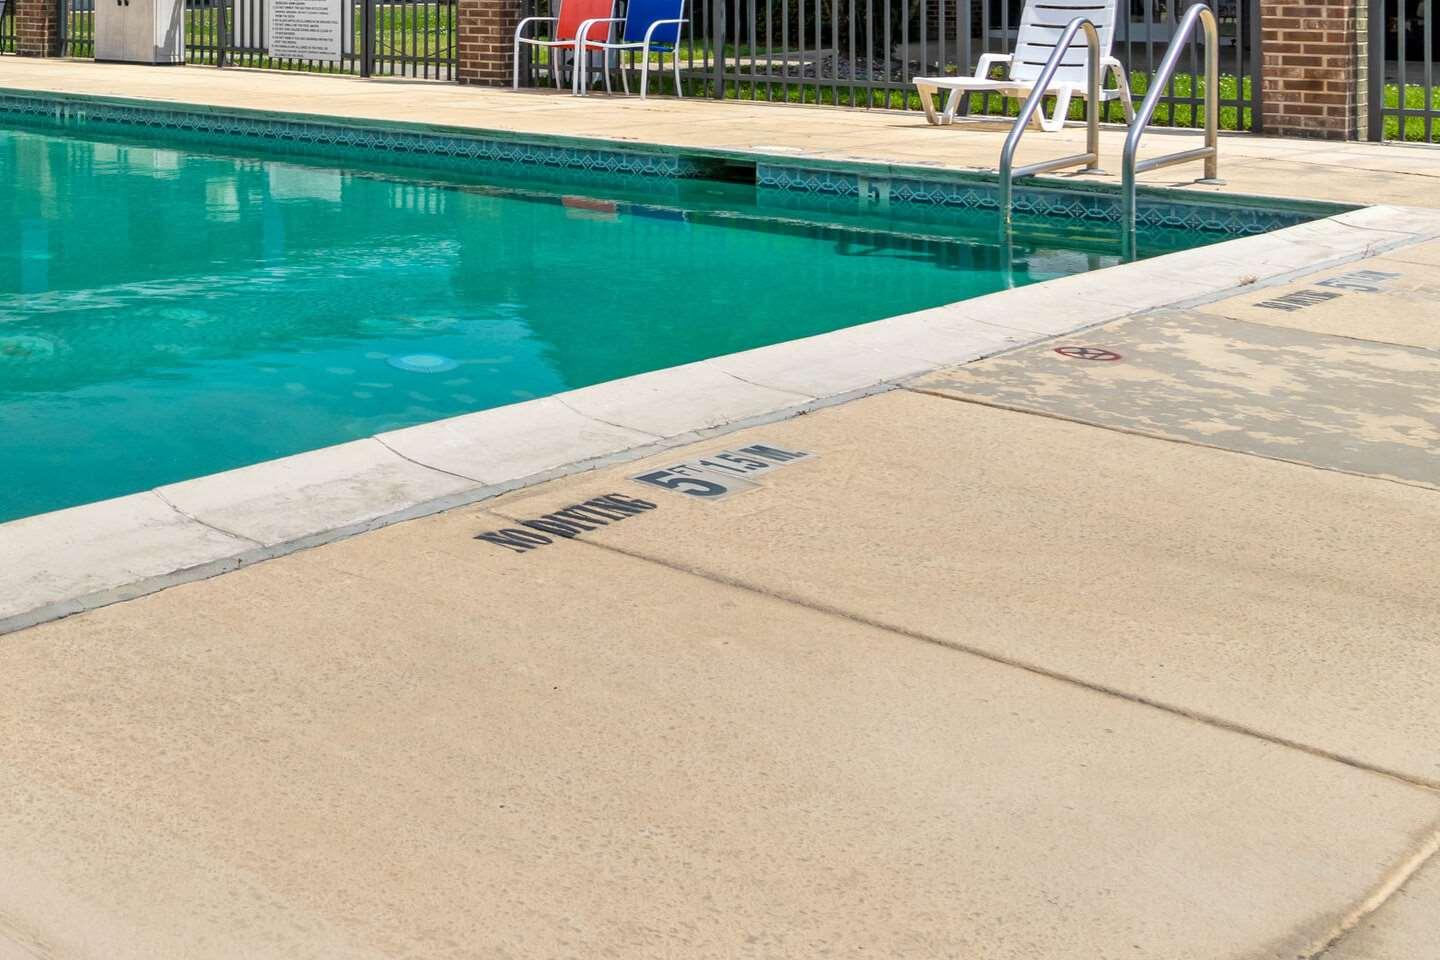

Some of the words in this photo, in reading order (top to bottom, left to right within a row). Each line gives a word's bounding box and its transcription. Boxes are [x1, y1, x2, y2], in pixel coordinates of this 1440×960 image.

[635, 470, 728, 497] 5
[473, 528, 553, 553] NO
[520, 493, 658, 539] DIVING
